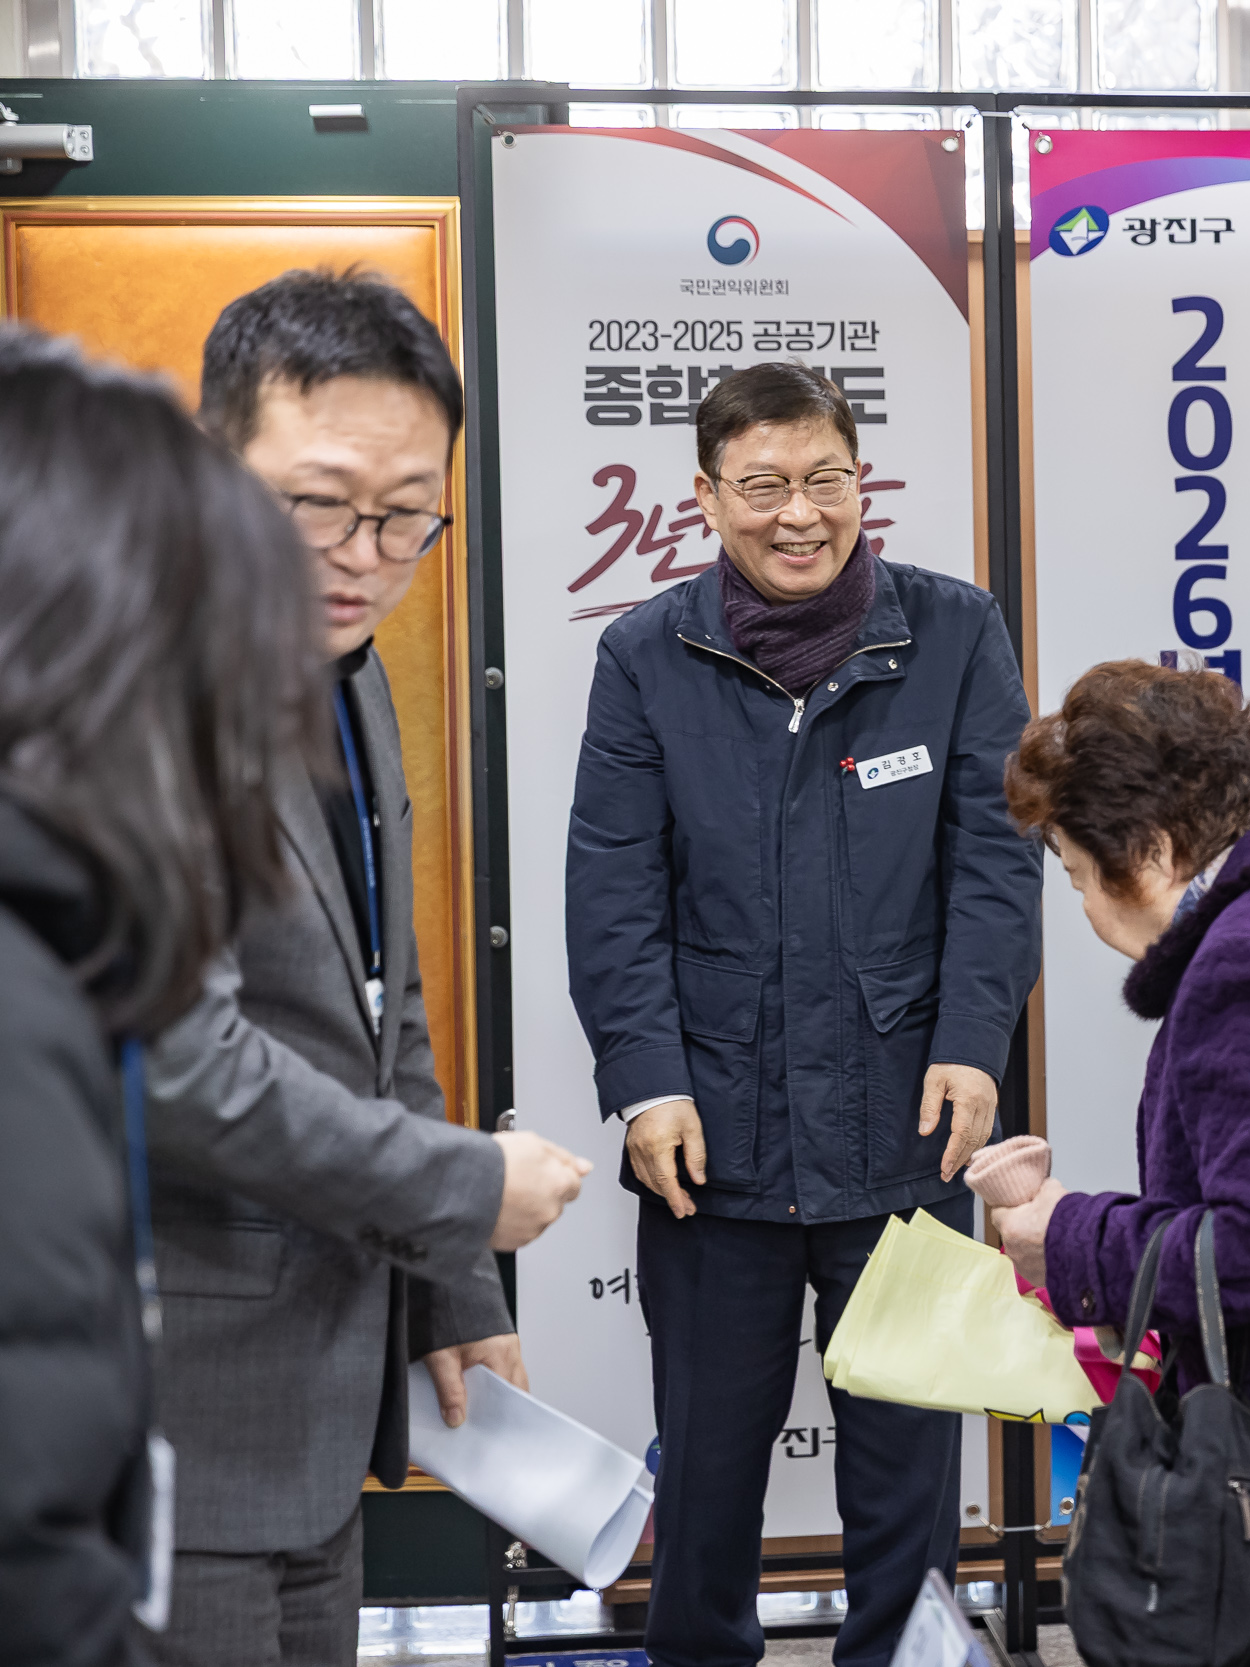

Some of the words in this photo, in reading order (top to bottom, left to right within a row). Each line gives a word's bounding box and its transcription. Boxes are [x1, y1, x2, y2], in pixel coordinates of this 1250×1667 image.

[1122, 217, 1236, 246] 광진구
[680, 279, 789, 296] 국민권익위원회
[588, 320, 743, 352] 2023-2025
[752, 320, 880, 352] 공공기관
[584, 364, 888, 426] 종합도
[1160, 296, 1243, 695] 2026
